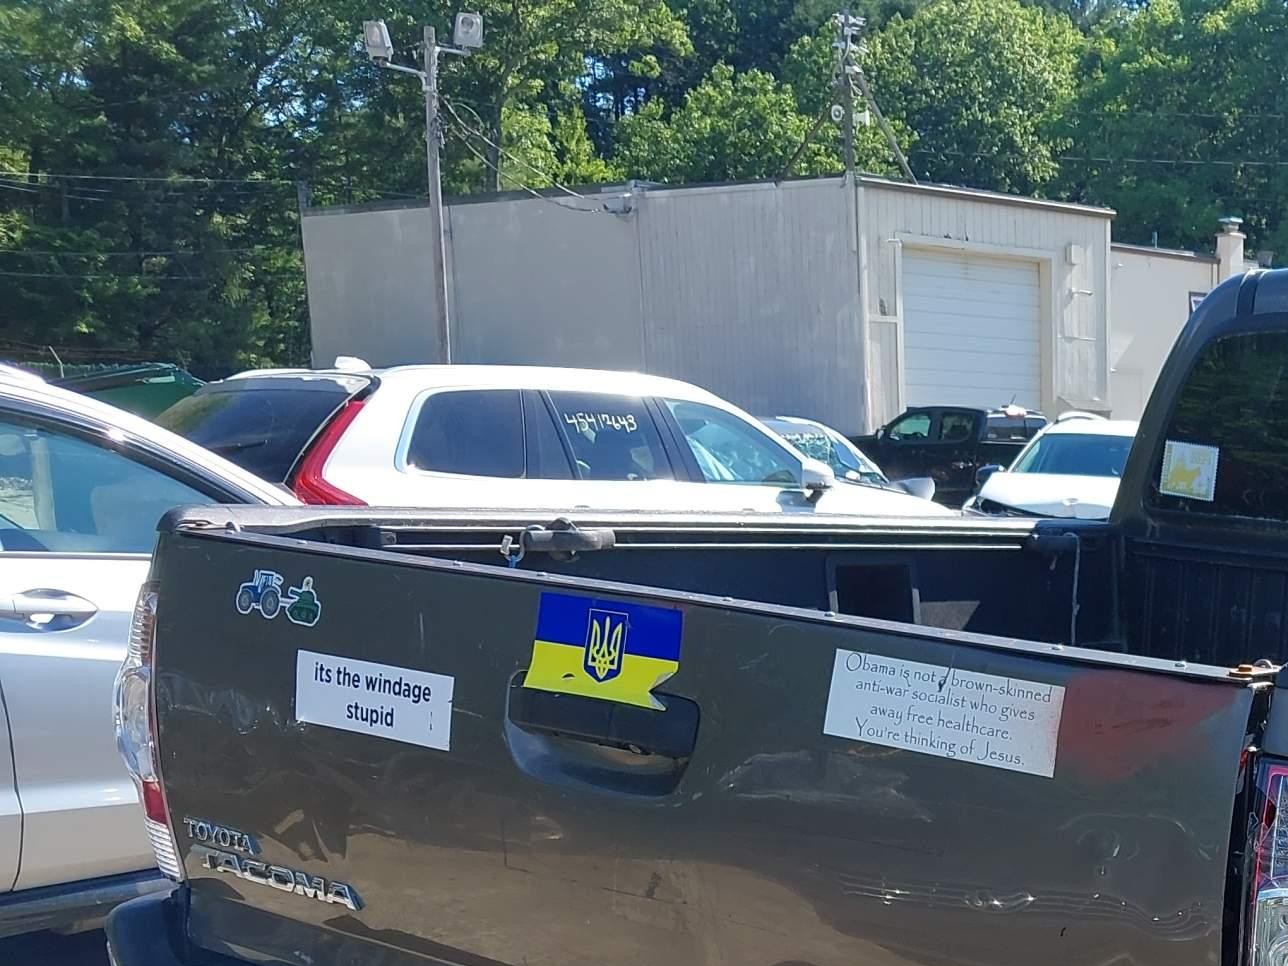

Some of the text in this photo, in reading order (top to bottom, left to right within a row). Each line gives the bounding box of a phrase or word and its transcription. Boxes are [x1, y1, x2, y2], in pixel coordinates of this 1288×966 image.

[314, 661, 431, 703] its the windage
[846, 652, 896, 675] Obama
[900, 664, 910, 678] is
[914, 671, 936, 682] not
[951, 669, 1053, 703] brown-skinned
[346, 702, 394, 727] stupid
[855, 679, 1035, 722] anti-war socialist who gives
[855, 716, 1025, 766] You're thinking of Jesus.
[870, 704, 1013, 742] away free healthcare.
[184, 816, 257, 856] TOYOTA
[200, 849, 361, 911] TACOMA
